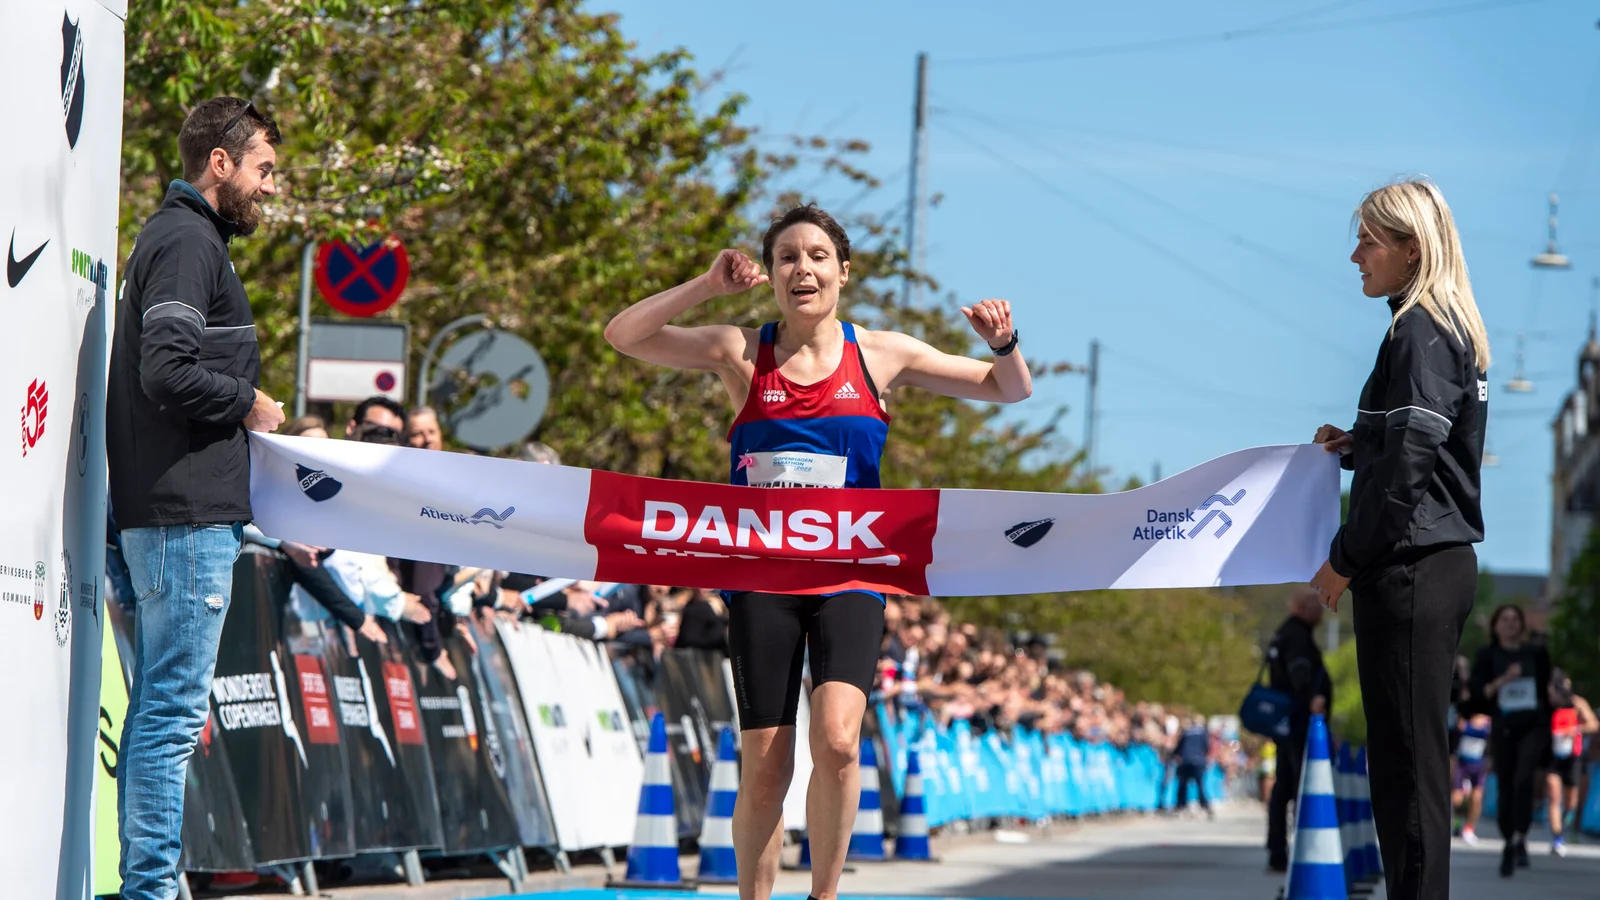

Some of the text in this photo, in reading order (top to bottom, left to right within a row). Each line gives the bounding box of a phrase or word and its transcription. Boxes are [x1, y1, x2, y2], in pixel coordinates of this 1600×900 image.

[420, 506, 469, 524] Atletik
[1147, 509, 1195, 523] Dansk
[641, 500, 886, 550] DANSK
[1133, 526, 1186, 540] Atletik
[3, 592, 30, 605] KOMMUNE
[219, 700, 282, 730] COPENHAGEN
